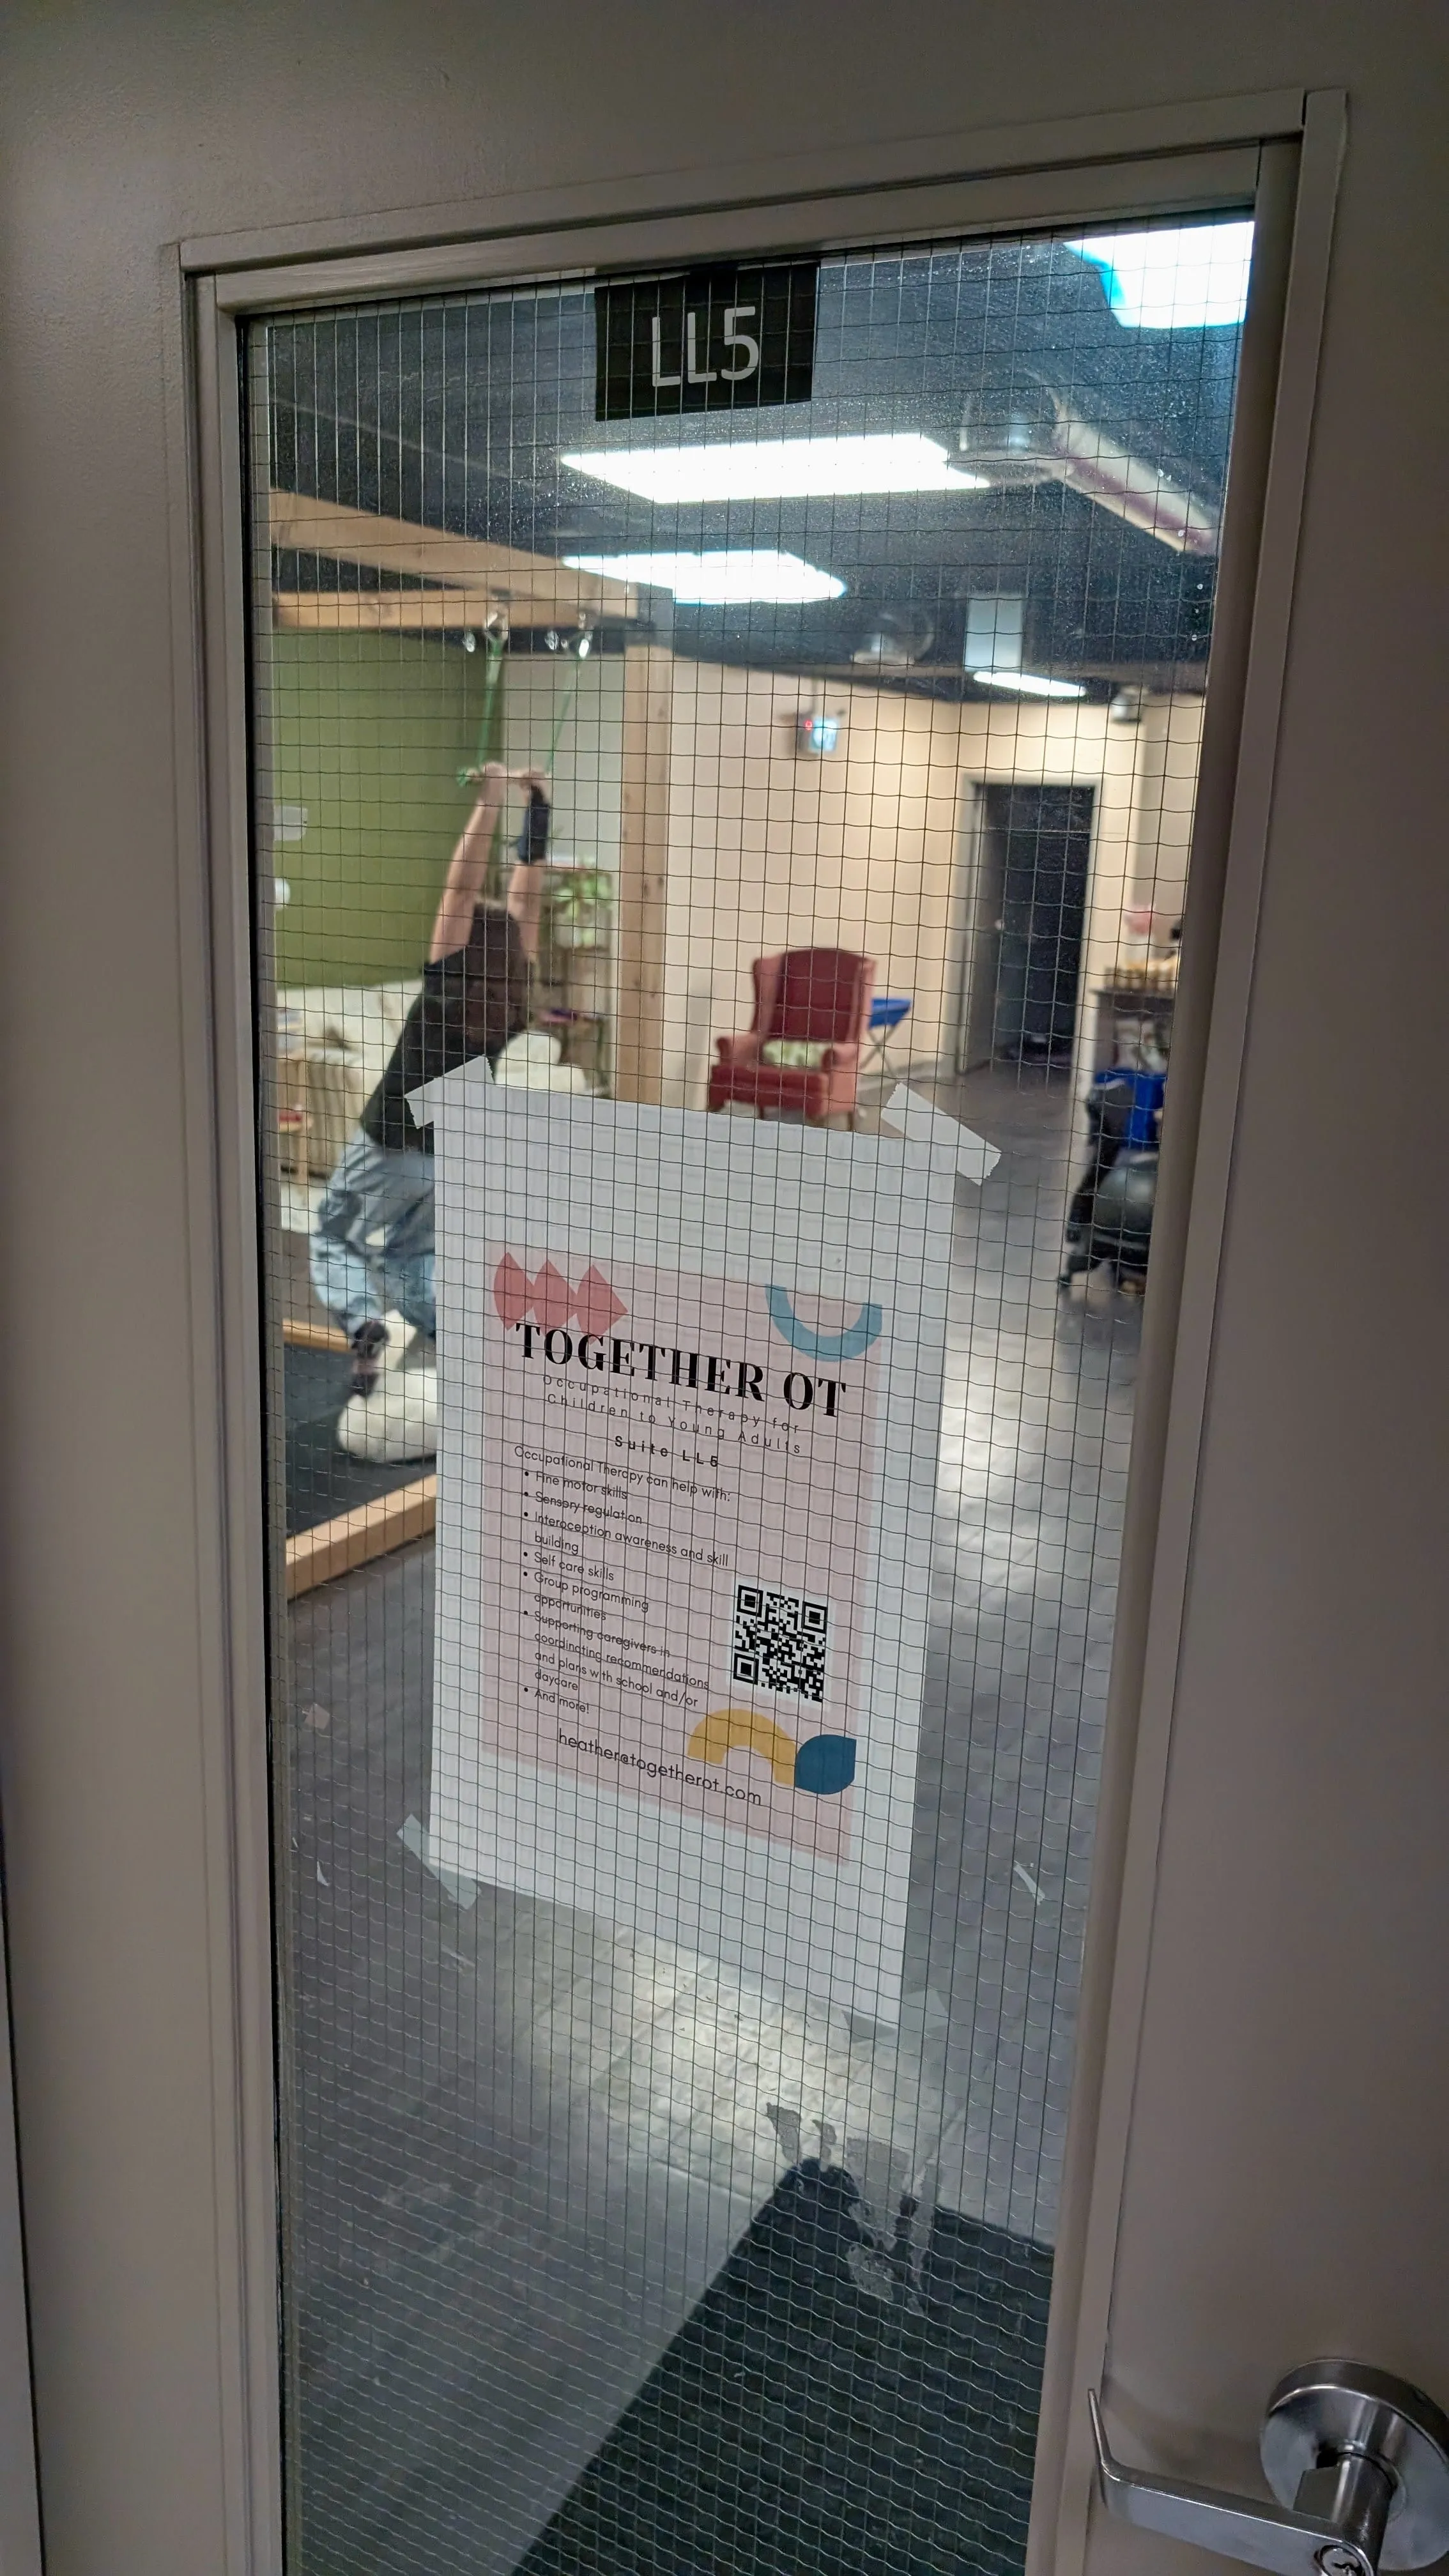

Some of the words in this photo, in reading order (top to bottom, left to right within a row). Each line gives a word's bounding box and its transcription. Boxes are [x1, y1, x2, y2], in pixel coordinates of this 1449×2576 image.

[652, 306, 759, 387] LL5
[515, 1322, 765, 1402] TOGETHER
[783, 1372, 847, 1417] OT
[543, 1374, 670, 1407] Occupational
[682, 1400, 760, 1427] Therapy
[772, 1417, 799, 1434] for
[548, 1393, 627, 1418] Children
[640, 1411, 656, 1423] to
[668, 1416, 724, 1439] Young
[738, 1430, 800, 1453] Adults
[514, 1446, 594, 1471] Occupational
[597, 1460, 643, 1485] Therapy
[647, 1476, 668, 1488] can
[672, 1478, 698, 1497] help
[702, 1487, 731, 1501] with:
[615, 1436, 668, 1457] Suite
[682, 1450, 718, 1468] LL5
[535, 1470, 560, 1485] Fine
[563, 1480, 598, 1493] motor
[601, 1483, 627, 1500] skills
[535, 1491, 580, 1514] Sensory
[535, 1511, 611, 1538] Interoception
[615, 1532, 677, 1554] awareness
[680, 1548, 703, 1561] and
[707, 1551, 728, 1567] skill
[535, 1530, 579, 1555] building
[534, 1551, 556, 1566] Self
[559, 1561, 584, 1574] care
[588, 1565, 614, 1581] skills
[534, 1572, 569, 1593] Group
[572, 1584, 649, 1613] programming
[534, 1594, 606, 1621] opportunities
[534, 1610, 594, 1641] Supporting
[597, 1632, 657, 1655] caregivers
[660, 1646, 670, 1658] in
[534, 1633, 602, 1663] coordinating
[606, 1654, 709, 1690] recommendations
[535, 1652, 555, 1664] and
[558, 1657, 587, 1675] plans
[616, 1676, 652, 1694] school
[656, 1689, 698, 1706] and/or
[535, 1669, 578, 1690] daycare
[534, 1689, 555, 1703] And
[559, 1698, 589, 1714] more!
[559, 1728, 762, 1805] heather@togetherot.com
